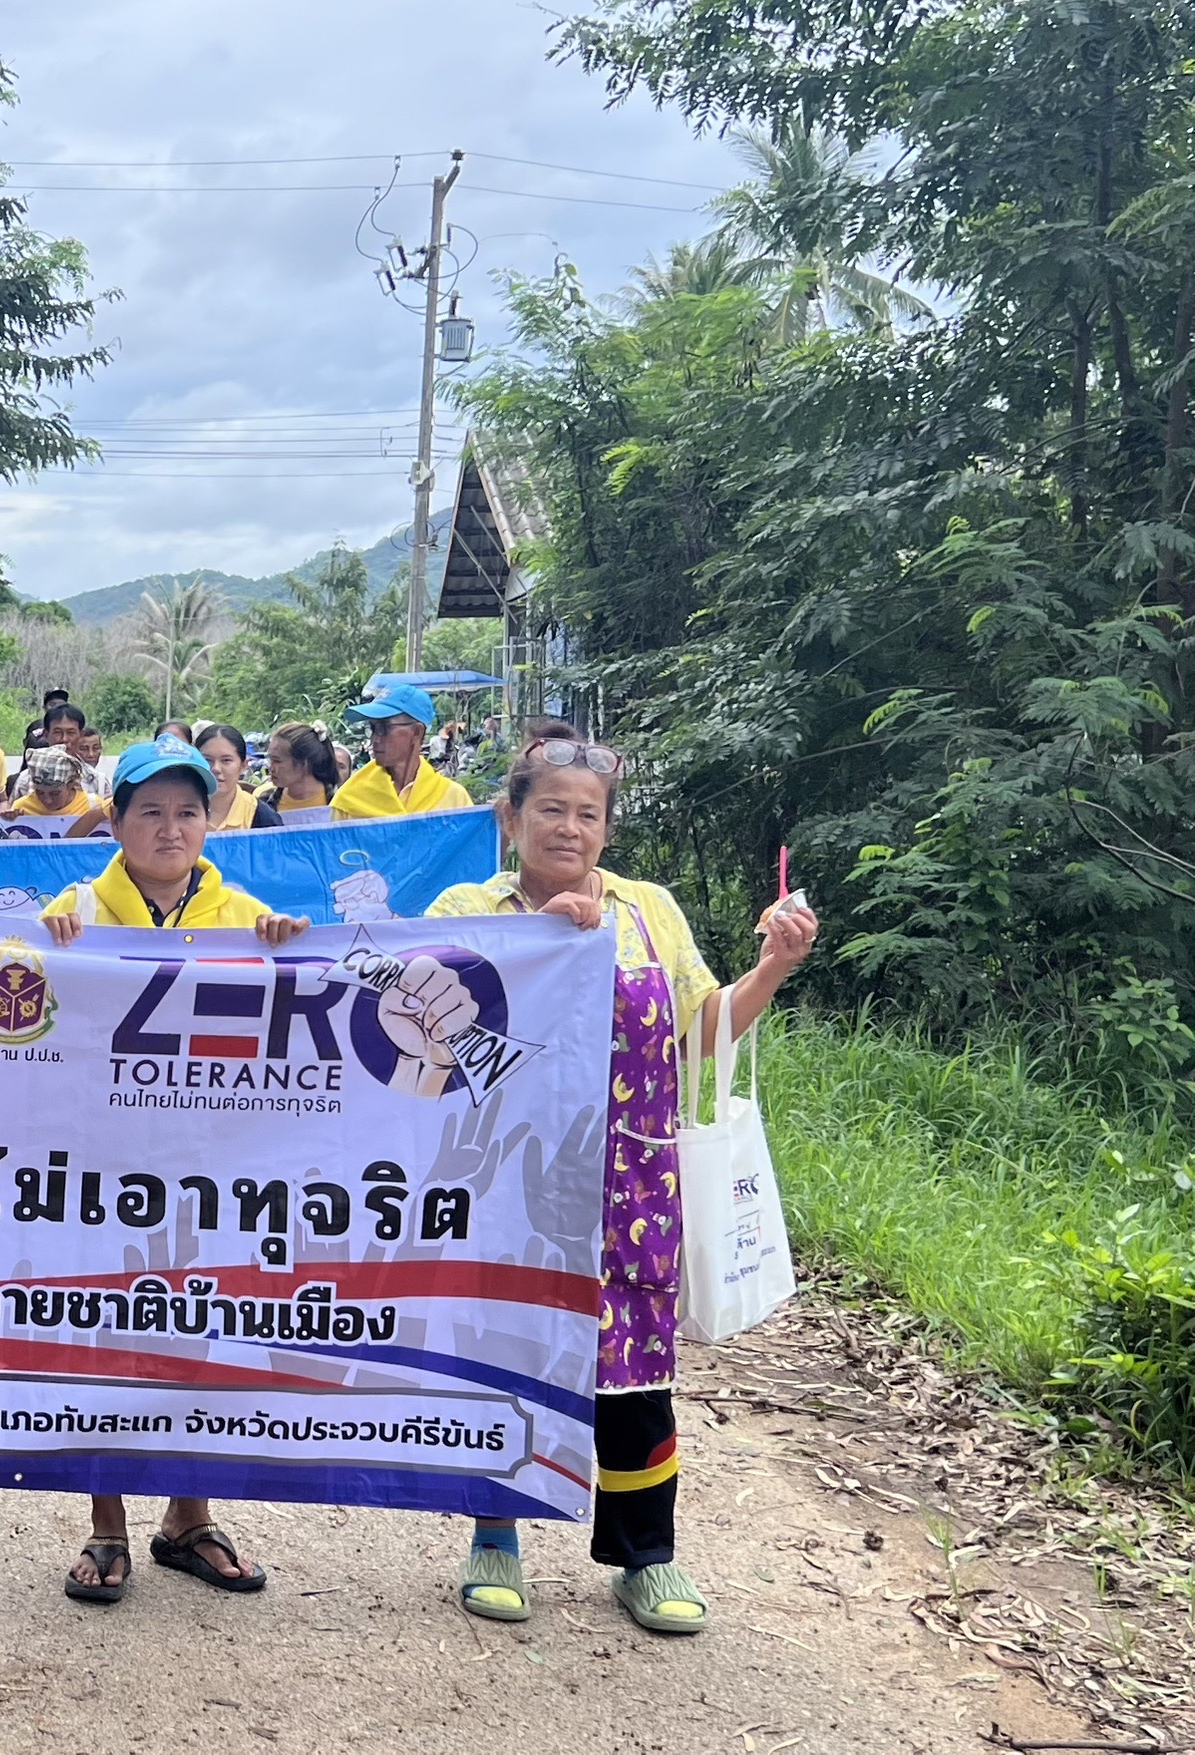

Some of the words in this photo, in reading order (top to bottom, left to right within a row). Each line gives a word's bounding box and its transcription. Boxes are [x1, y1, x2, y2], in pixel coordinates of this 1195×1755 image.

[111, 945, 509, 1097] ZERO
[25, 1048, 64, 1063] ป.ป.ช.
[109, 1058, 343, 1091] TOLERANCE
[109, 1089, 342, 1118] คนไทยไม่ทนต่อการทุจริต
[185, 1408, 506, 1453] จังหวัดประจวบคีรีขันธ์
